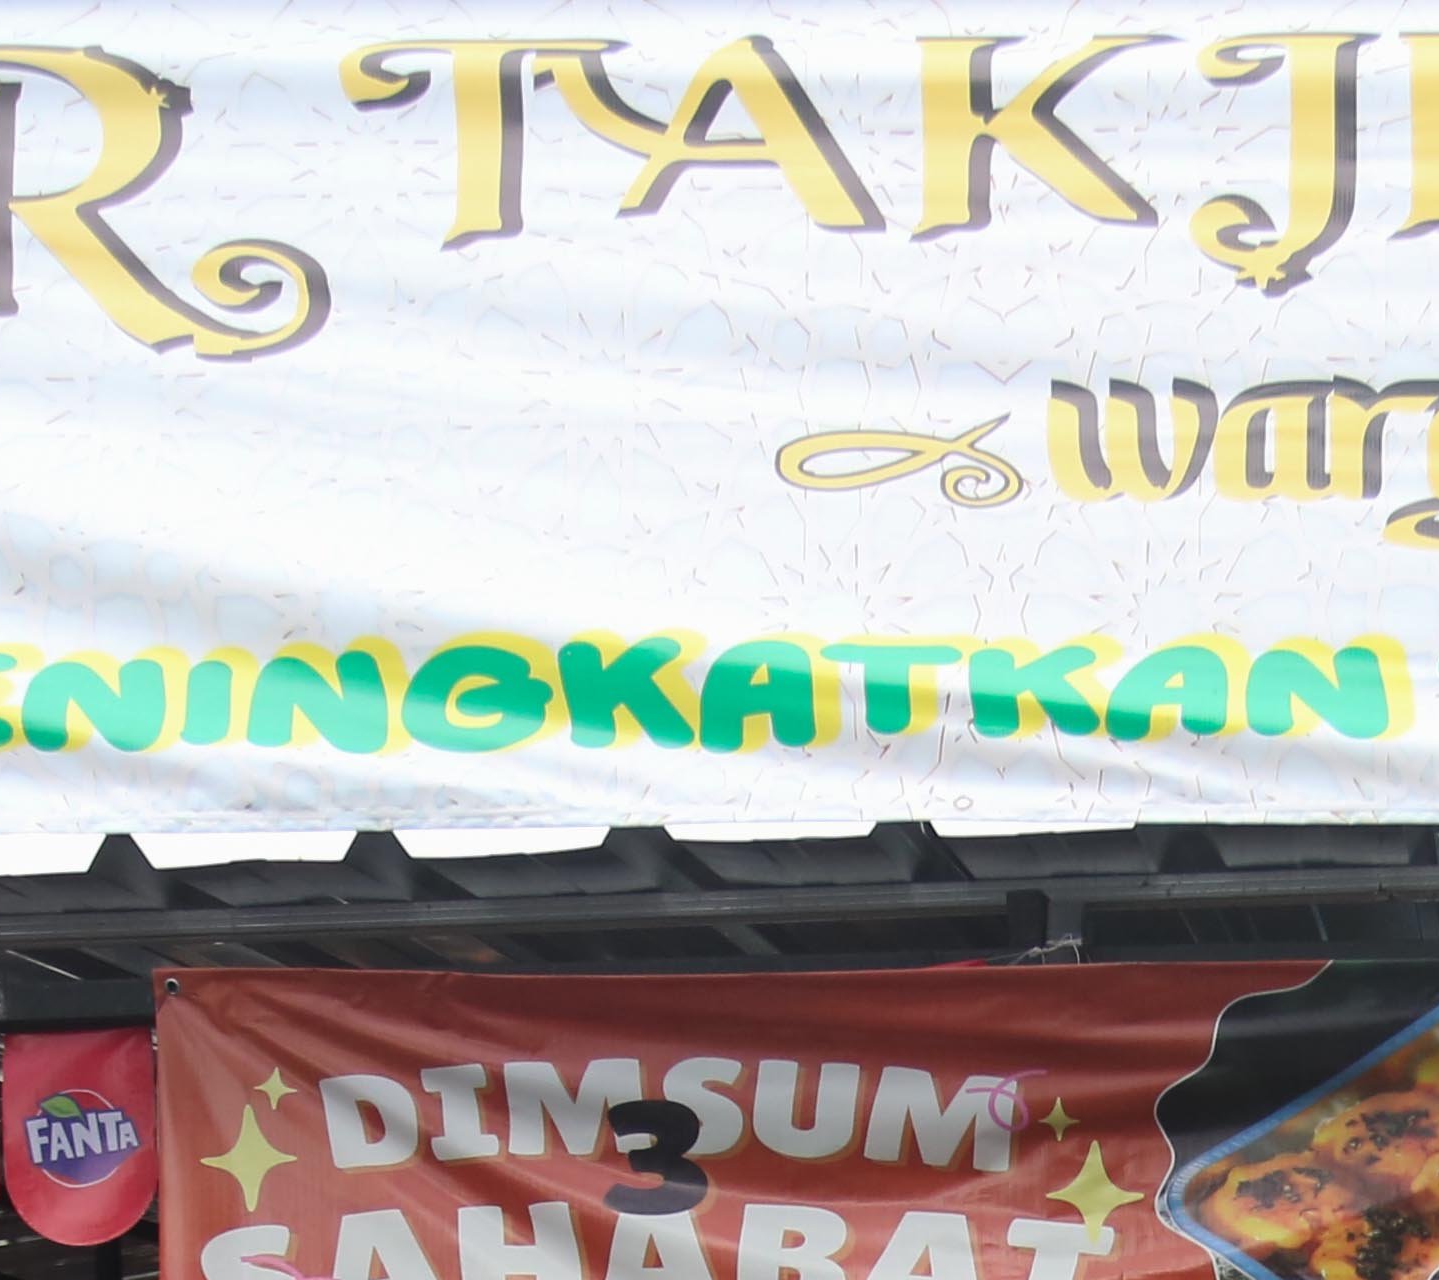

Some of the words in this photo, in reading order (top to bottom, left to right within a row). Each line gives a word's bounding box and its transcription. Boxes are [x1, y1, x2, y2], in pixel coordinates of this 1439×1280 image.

[25, 1106, 140, 1165] FANTA
[318, 1057, 1017, 1175] DIMSUM
[603, 1098, 710, 1215] 3
